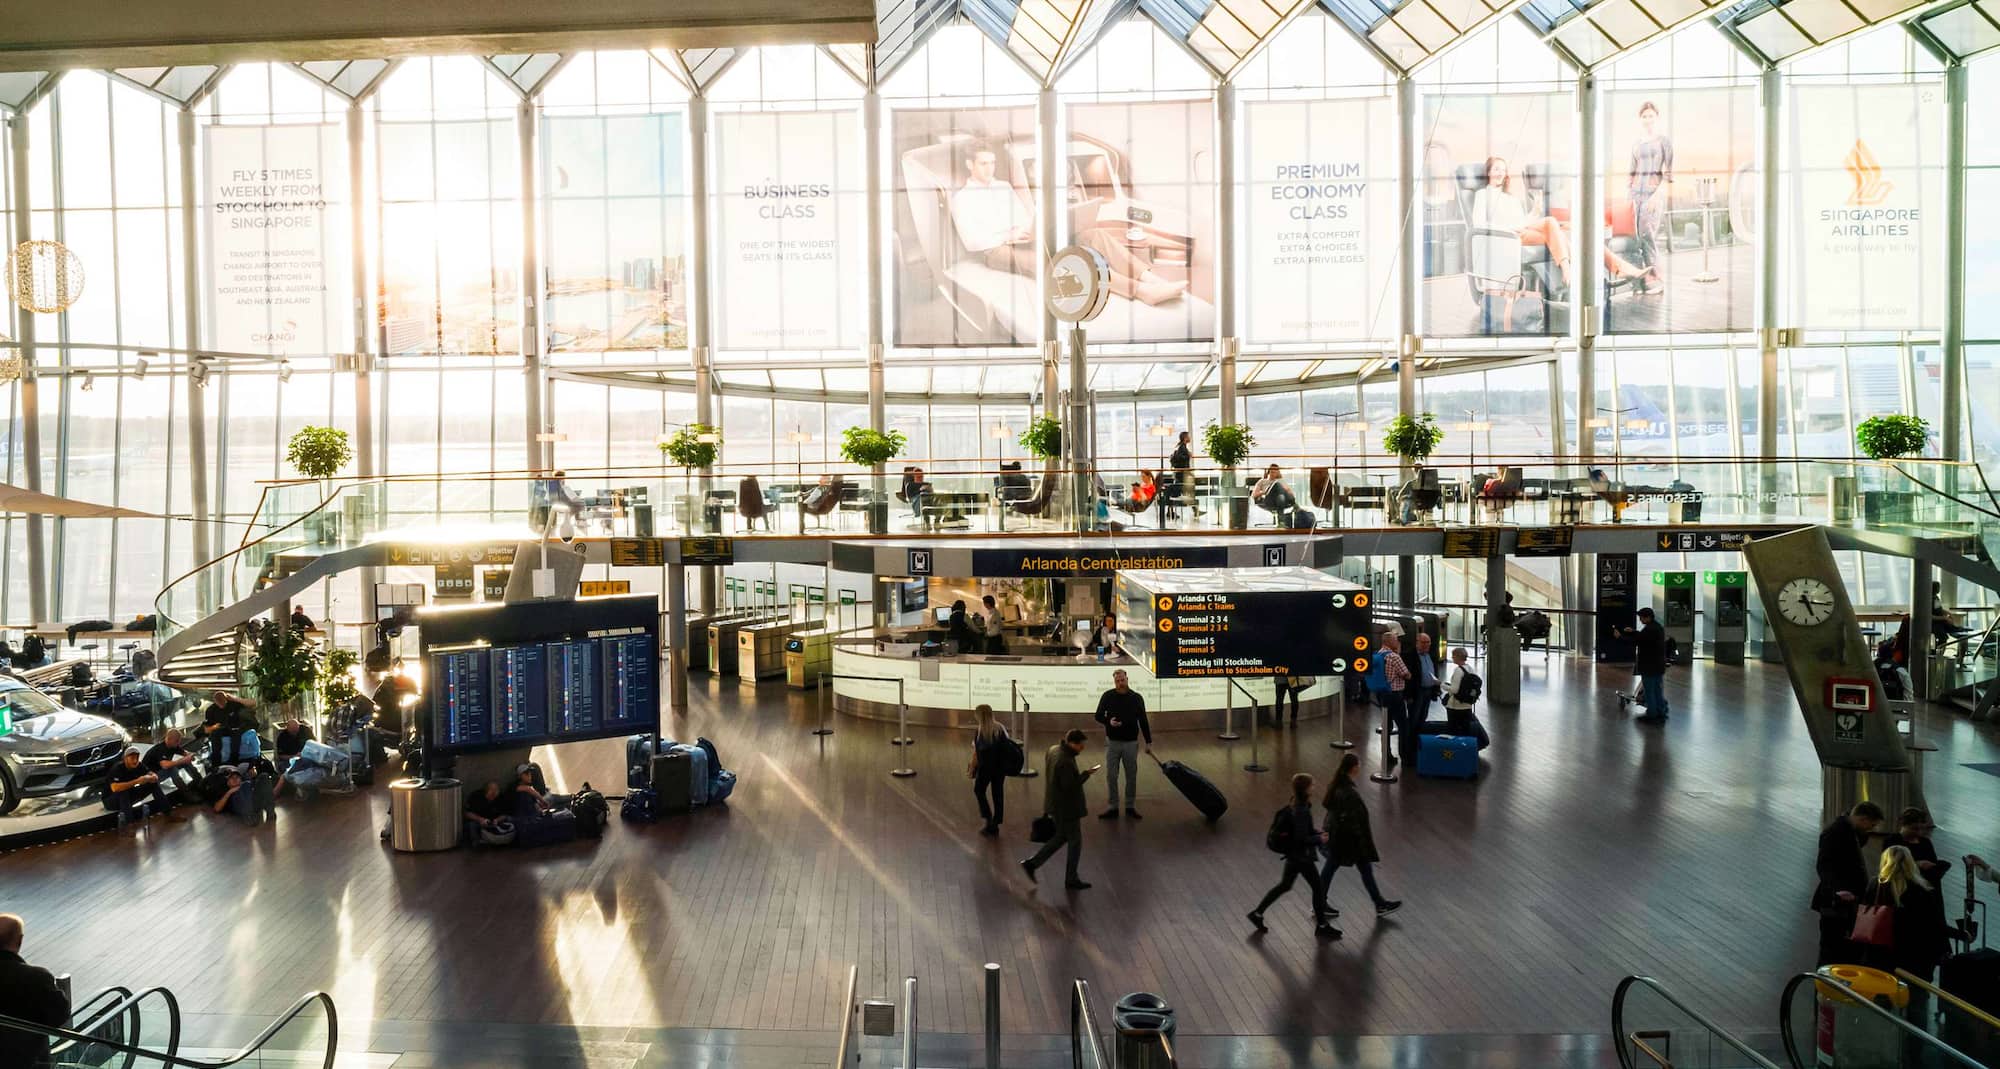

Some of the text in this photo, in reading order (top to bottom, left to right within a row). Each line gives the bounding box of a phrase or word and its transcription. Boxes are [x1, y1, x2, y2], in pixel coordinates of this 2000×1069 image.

[232, 168, 313, 182] FLY 5 TIMES
[1276, 163, 1360, 179] PREMIUM
[220, 183, 322, 198] WEEKLY FROM
[744, 184, 830, 200] BUSINESS
[1271, 183, 1366, 200] ECONOMY
[216, 201, 304, 214] STOCKHOLM
[758, 204, 816, 220] CLASS
[1289, 204, 1348, 220] CLASS
[1820, 208, 1920, 221] SINGAPORE
[231, 216, 313, 229] SINGAPORE
[1277, 230, 1360, 241] EXTRA COMFORT
[1831, 224, 1909, 236] AIRLINES
[777, 240, 797, 249] THE
[1280, 242, 1358, 253] EXTRA CHOICES
[1273, 255, 1366, 265] EXTRA PRIVILEGES
[1020, 556, 1184, 570] Arlanda Centralstation
[1214, 602, 1236, 610] Trains
[1178, 616, 1228, 624] Terminal 2 3 4
[1178, 624, 1208, 632] Terminal
[1210, 624, 1215, 632] 2
[1222, 624, 1228, 632] 4
[1178, 637, 1215, 645] Terminal 5
[1178, 646, 1216, 654] Terminal 5
[1178, 658, 1262, 668] Snabbtåg till Stockholm
[1178, 668, 1206, 676] Express
[1236, 666, 1273, 674] Stockholm
[1274, 666, 1289, 675] City
